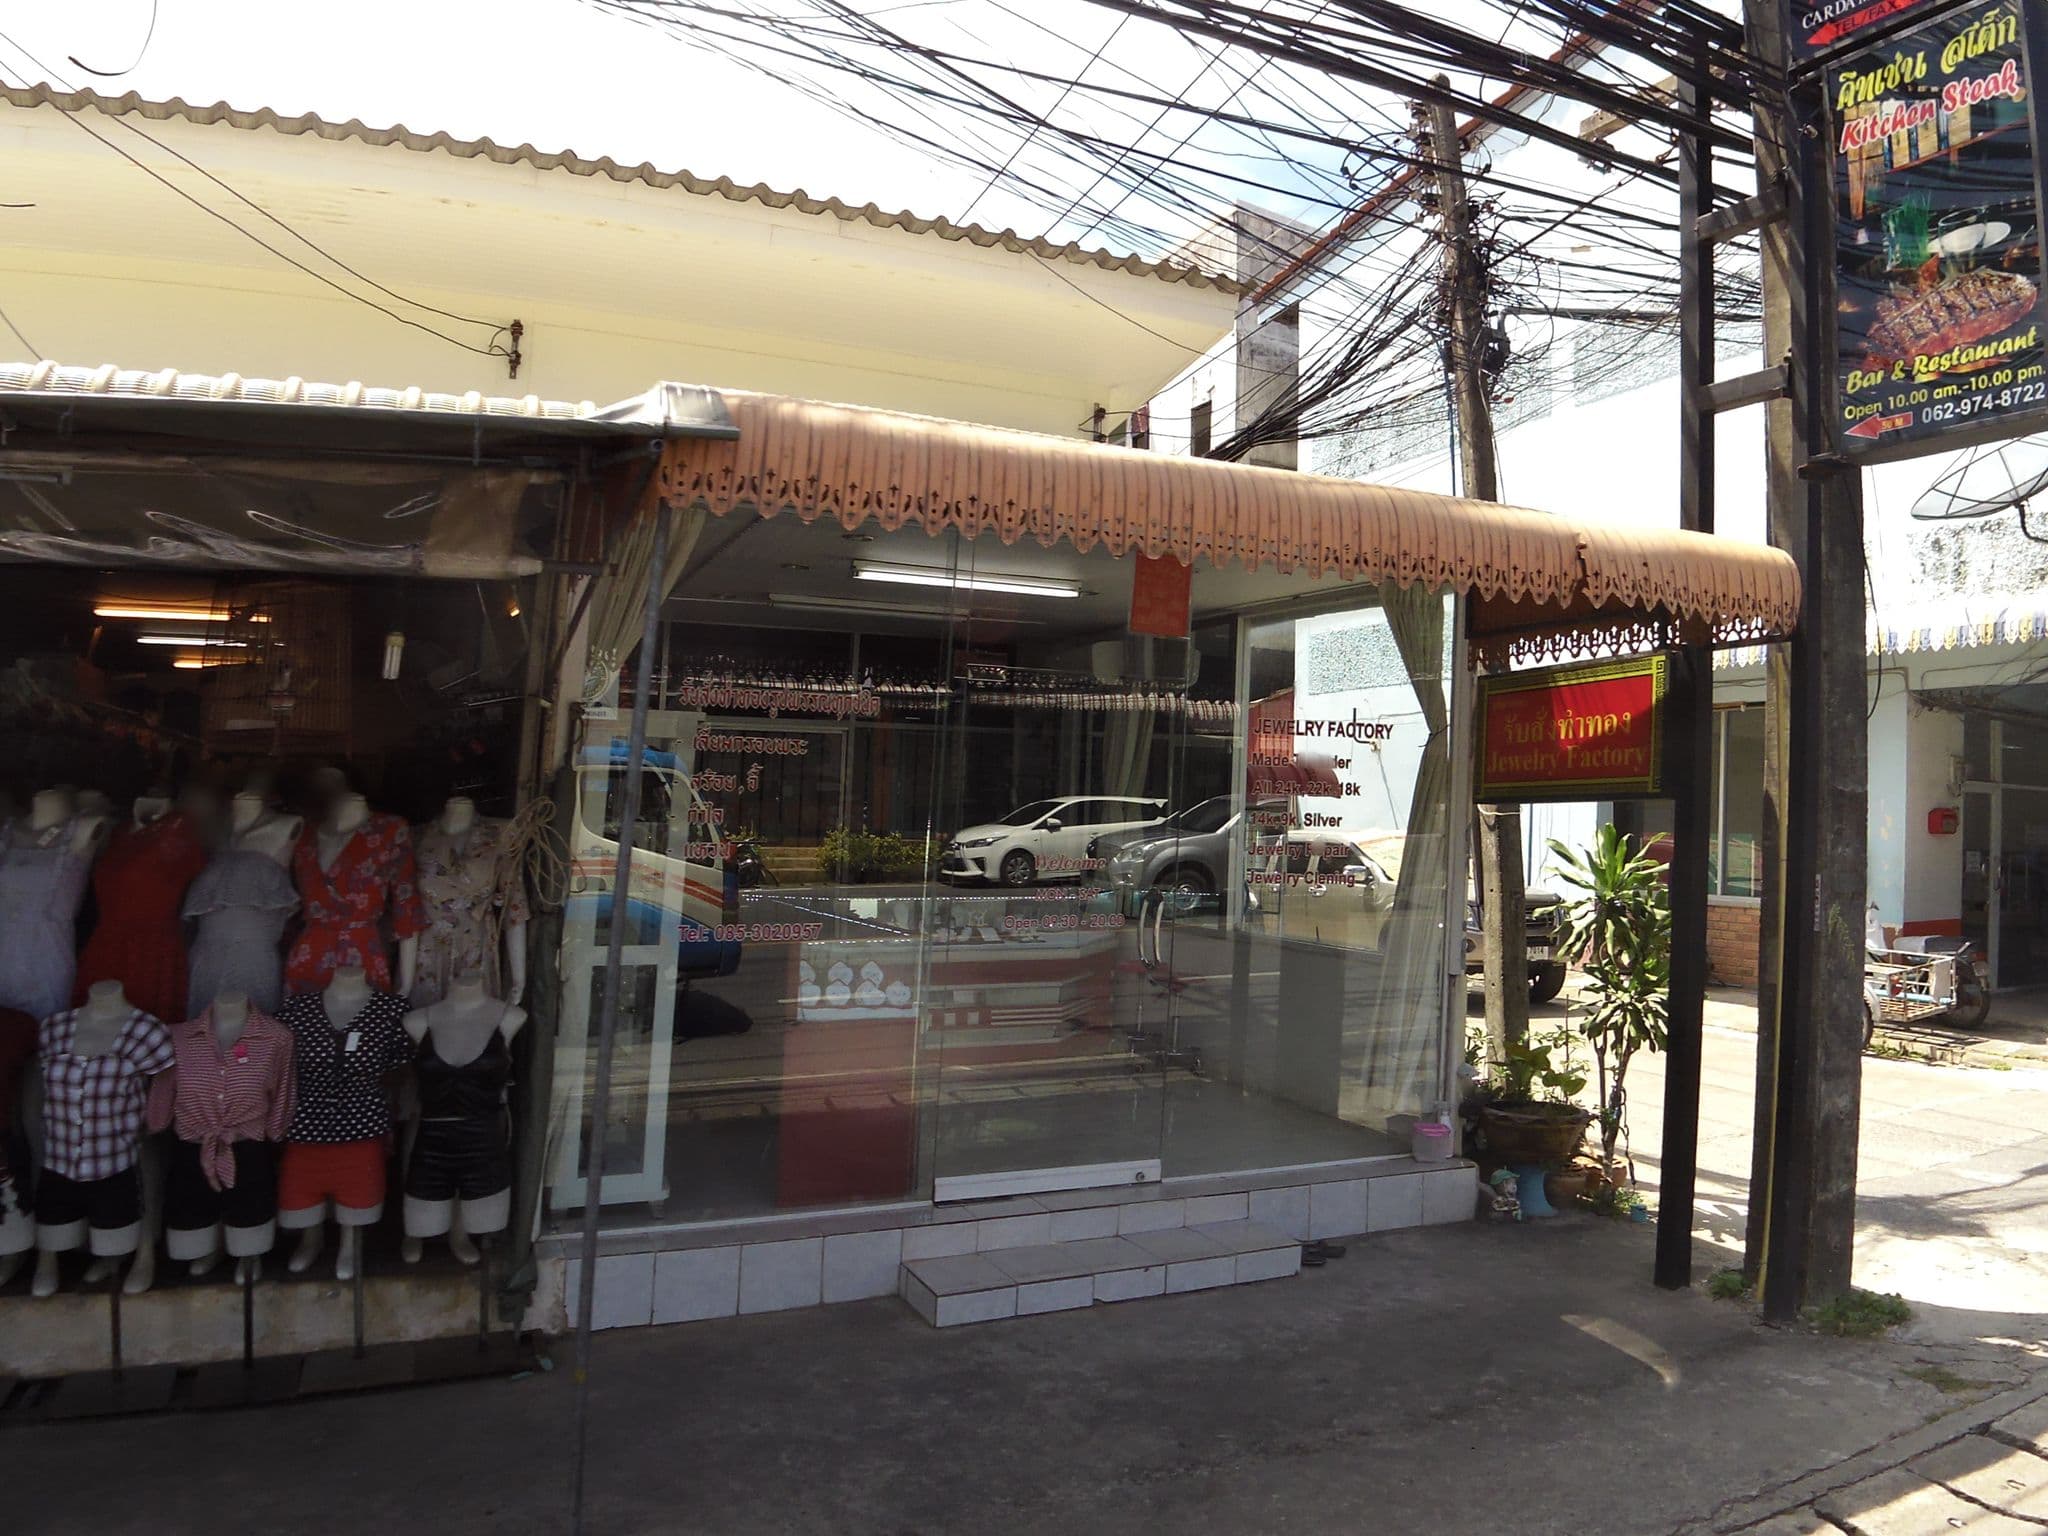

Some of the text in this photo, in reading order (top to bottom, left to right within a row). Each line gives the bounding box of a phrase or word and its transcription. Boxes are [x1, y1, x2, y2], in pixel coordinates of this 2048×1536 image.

[1940, 8, 2017, 74] สเต็ก
[1839, 58, 2020, 154] Kitchen Steak
[1846, 326, 2037, 394] Bar & Restaurant
[1844, 402, 1882, 421] Open
[1888, 387, 1928, 410] 10.00
[2017, 364, 2046, 385] pm.
[1922, 382, 2046, 423] 062-974-8722
[1254, 718, 1393, 740] JEWELRY FACTORY
[1251, 753, 1289, 767] Made
[1487, 744, 1647, 776] Jewelry Factory
[1252, 781, 1272, 796] All
[1304, 813, 1343, 827] Silver
[1248, 842, 1349, 859] Jewelry Rpair
[1034, 854, 1107, 871] Welcome
[1247, 870, 1303, 886] Jewelry
[713, 922, 824, 942] 085-3020957
[1003, 915, 1037, 930] Open
